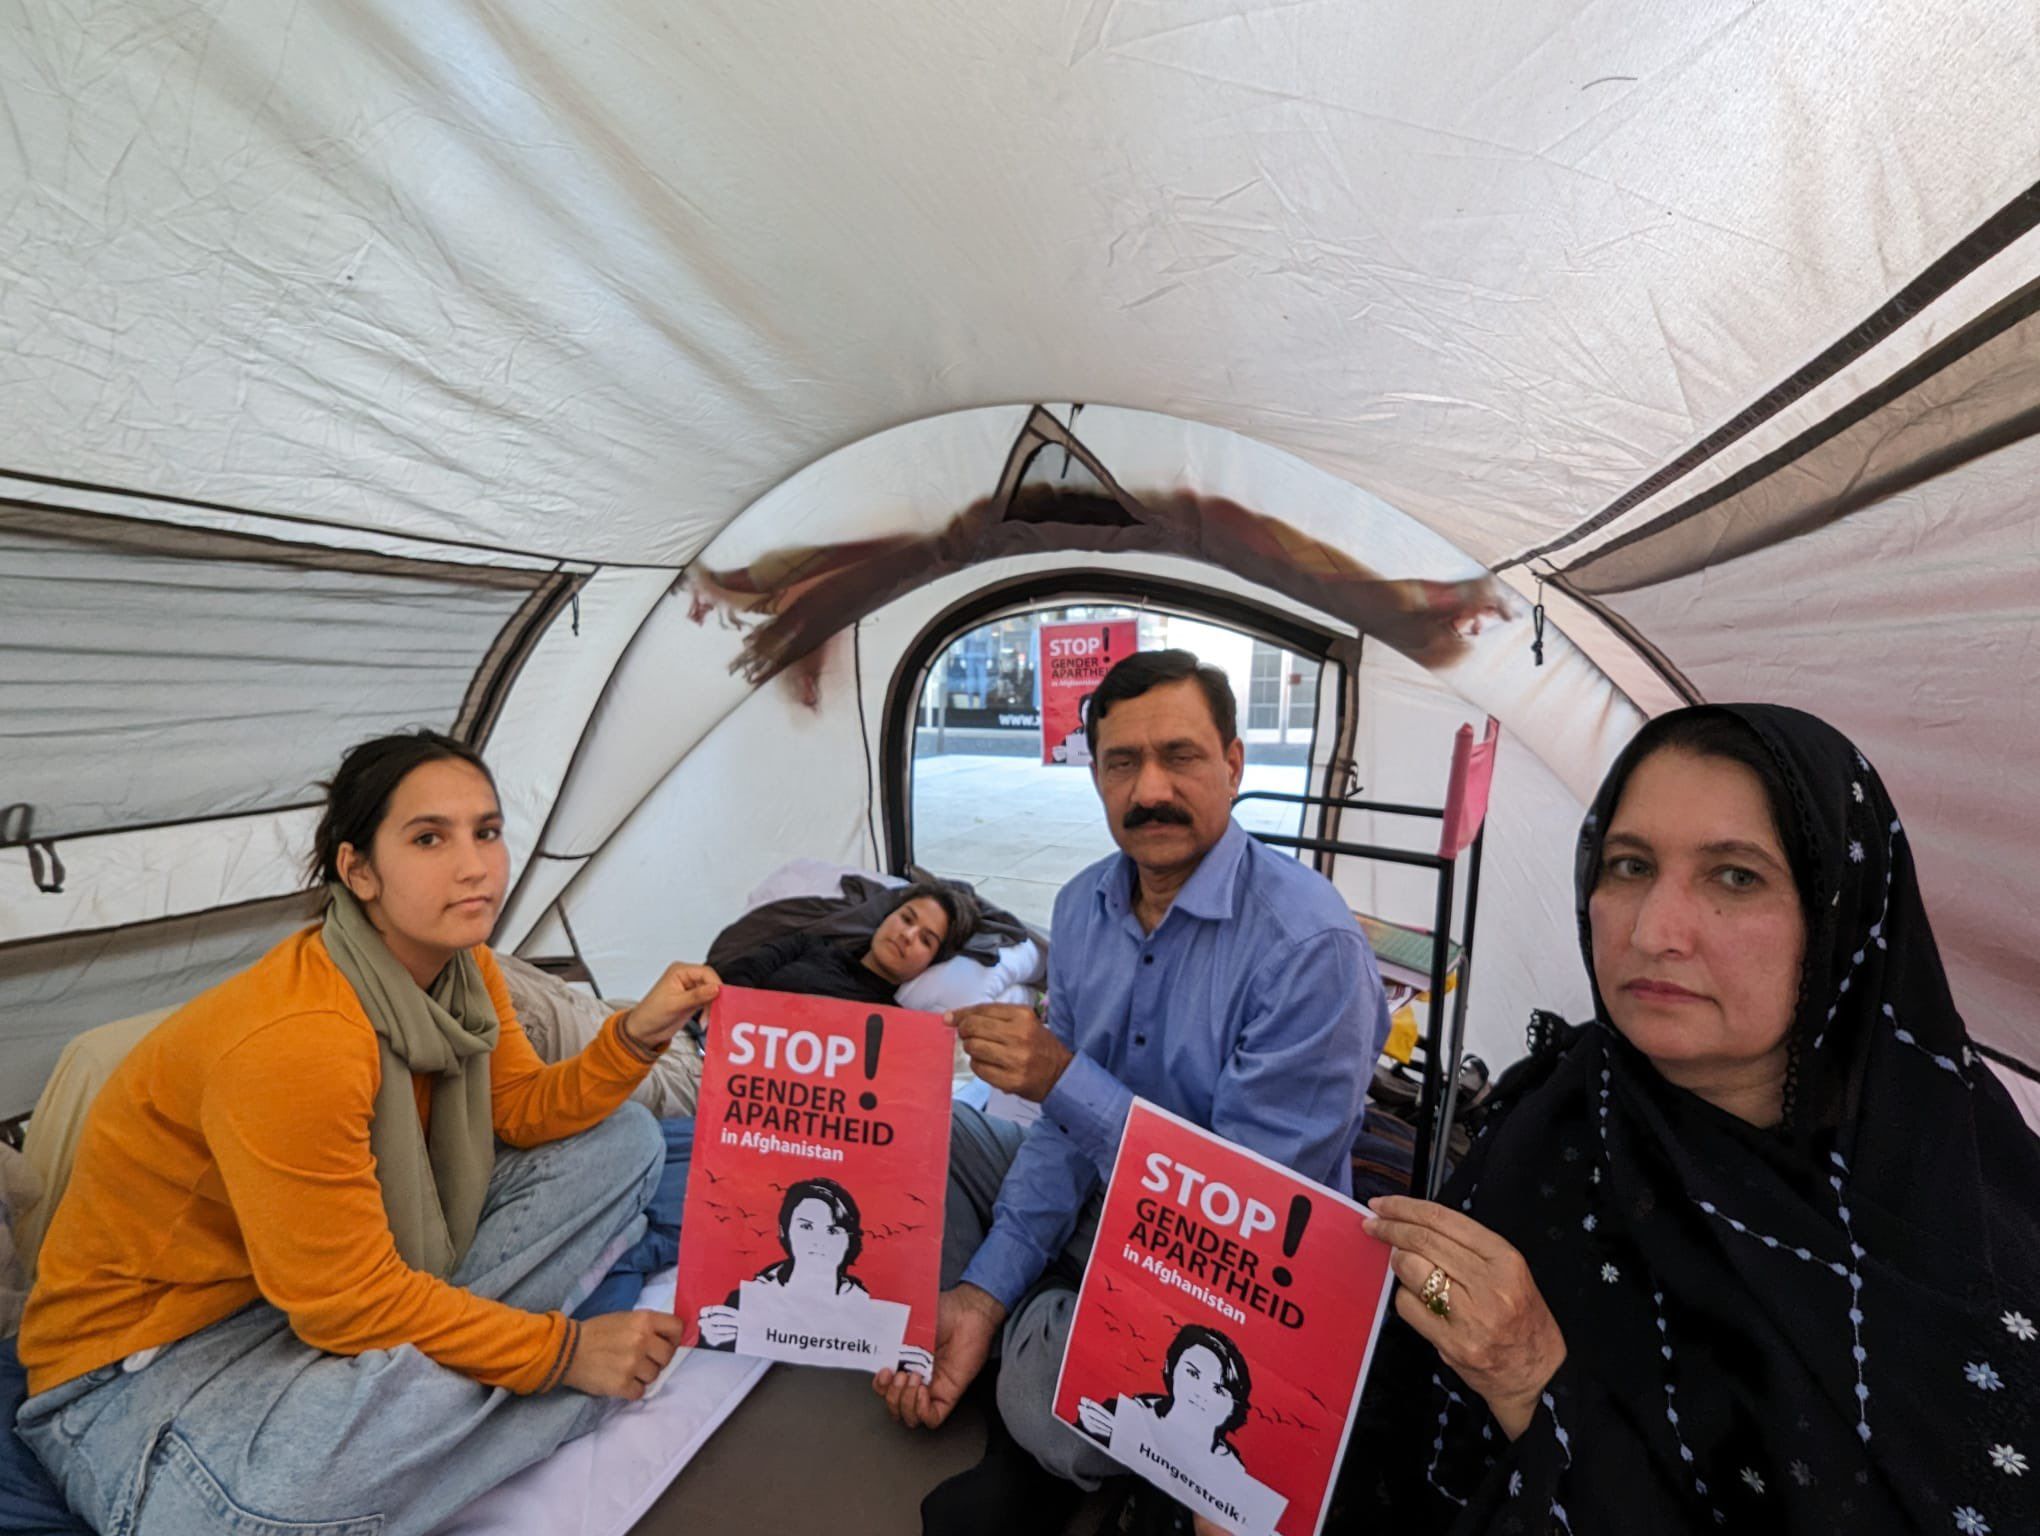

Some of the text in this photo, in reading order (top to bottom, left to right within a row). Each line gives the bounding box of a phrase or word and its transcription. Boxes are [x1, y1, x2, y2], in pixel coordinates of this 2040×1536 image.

[1051, 657, 1099, 669] GENDER
[727, 1074, 846, 1114] GENDER
[721, 1128, 844, 1162] in Afghanistan
[724, 1100, 894, 1146] APARTHEID
[1136, 1198, 1260, 1280] GENDER
[1122, 1244, 1246, 1325] in Afghanistan
[1128, 1222, 1305, 1330] APARTHEID
